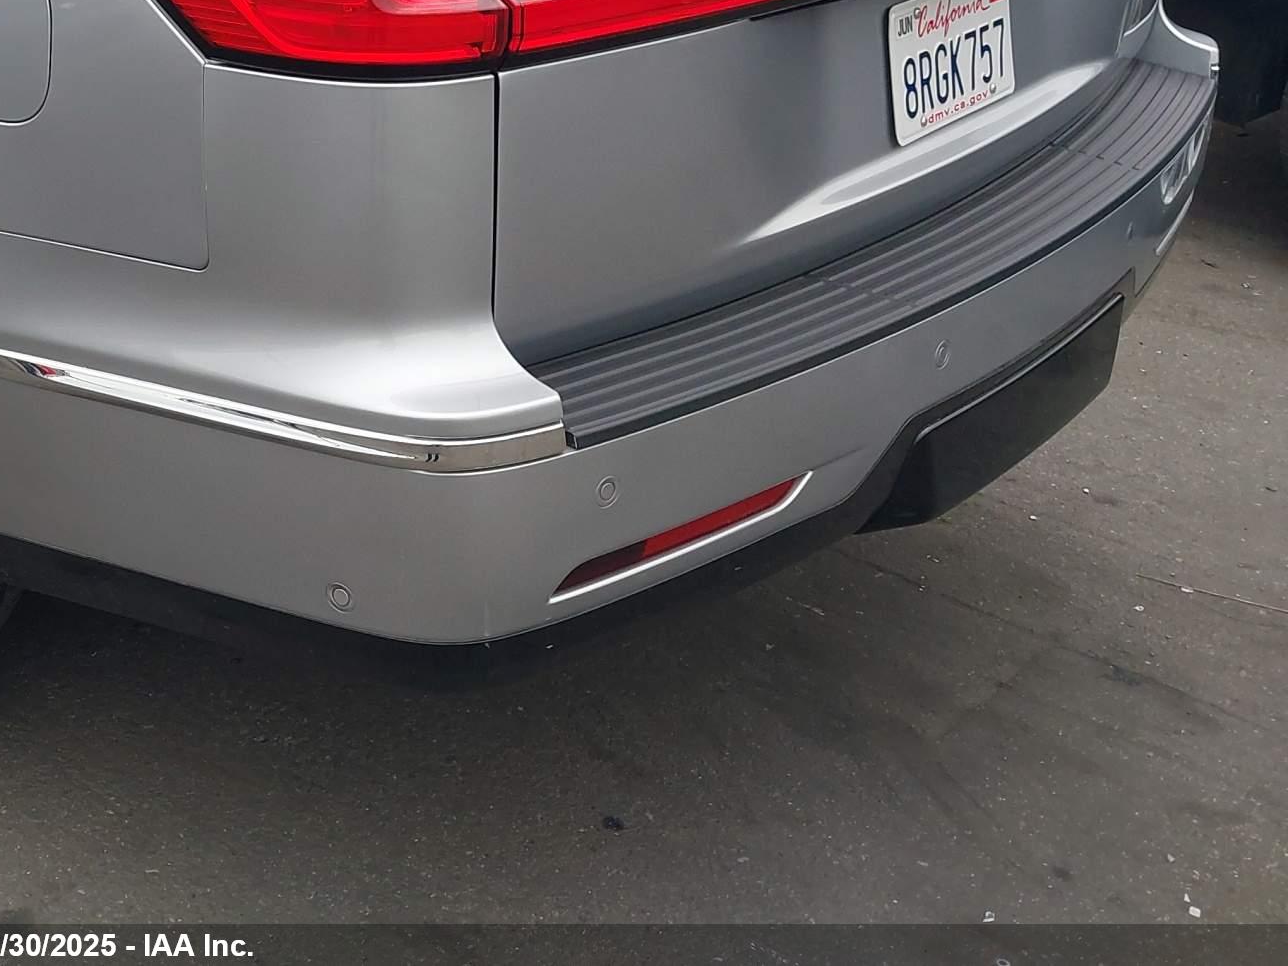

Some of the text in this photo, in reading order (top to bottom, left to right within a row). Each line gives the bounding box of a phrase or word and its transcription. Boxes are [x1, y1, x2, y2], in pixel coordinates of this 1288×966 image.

[897, 14, 913, 37] JUN
[903, 17, 1005, 119] 8RGK757
[928, 90, 989, 124] dmv.ca.gov
